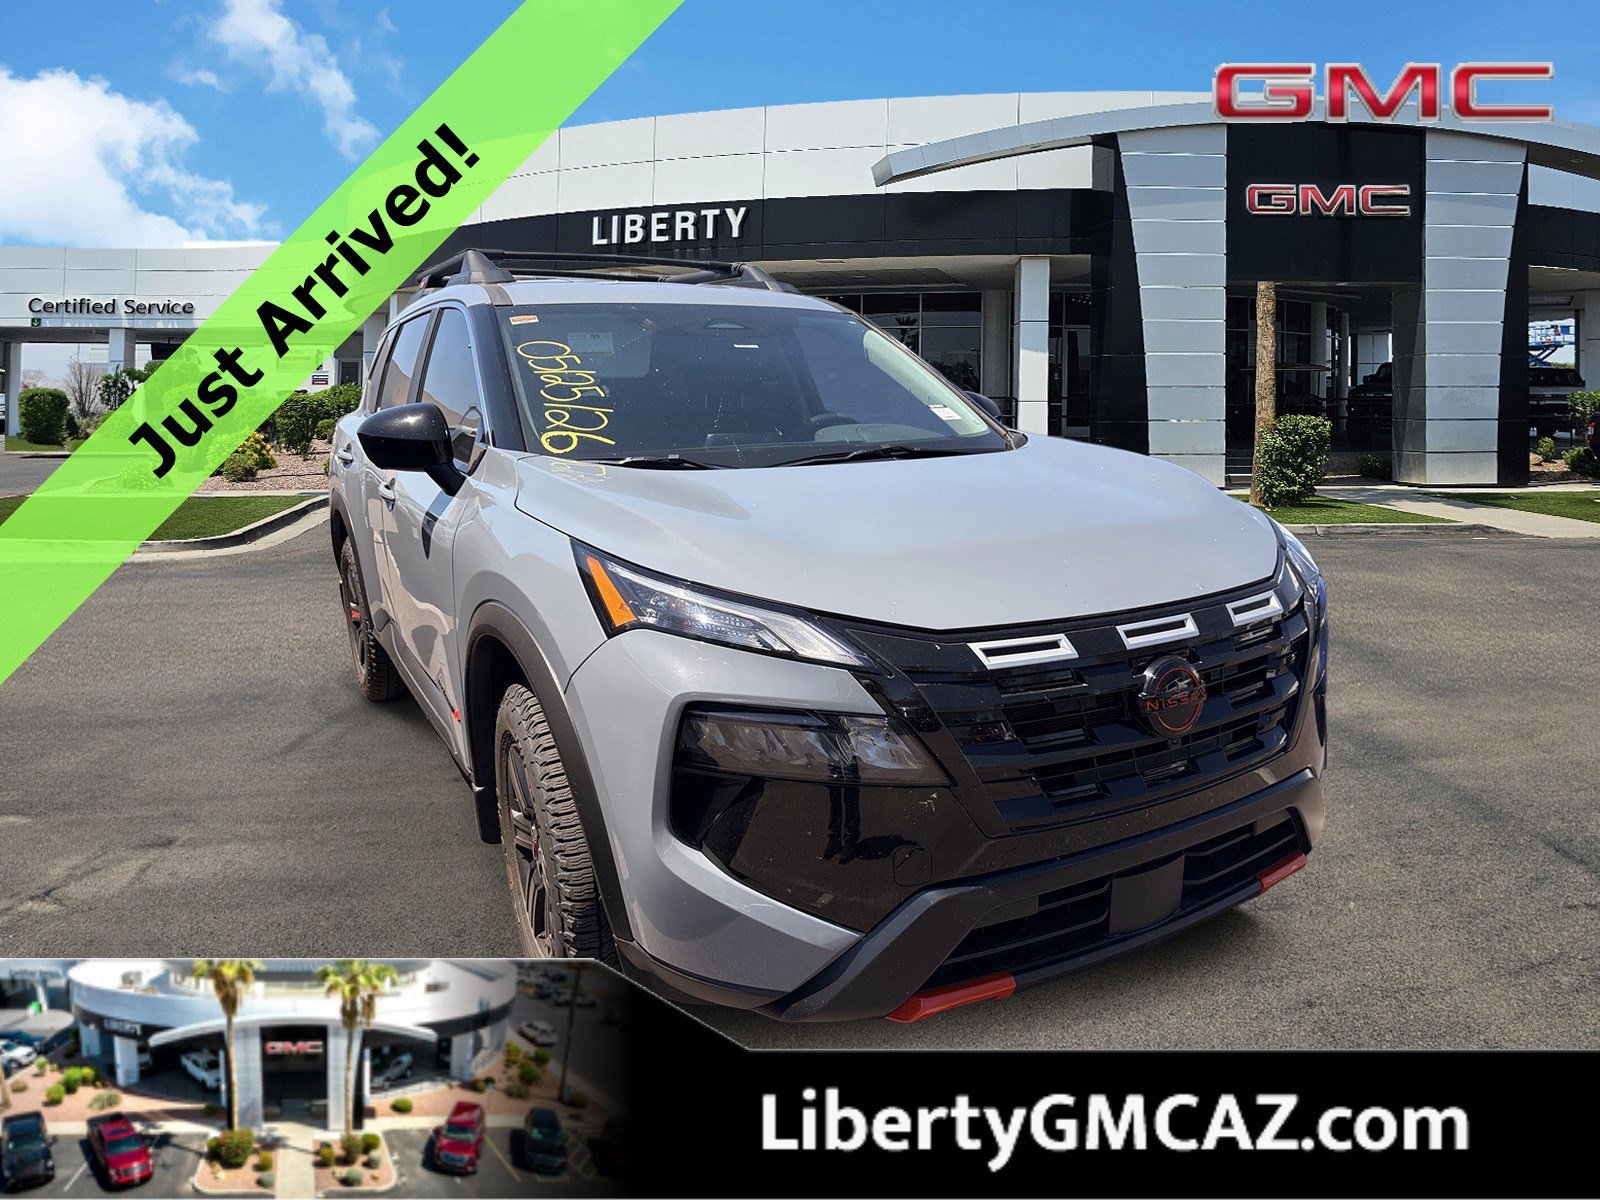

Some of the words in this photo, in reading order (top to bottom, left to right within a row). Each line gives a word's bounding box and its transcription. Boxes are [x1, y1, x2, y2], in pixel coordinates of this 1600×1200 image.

[1246, 184, 1412, 217] GMC
[592, 206, 748, 246] LIBERTY
[28, 297, 117, 315] Certified
[123, 298, 195, 315] Service
[1145, 689, 1207, 712] NISSAN
[266, 1040, 323, 1055] GMC
